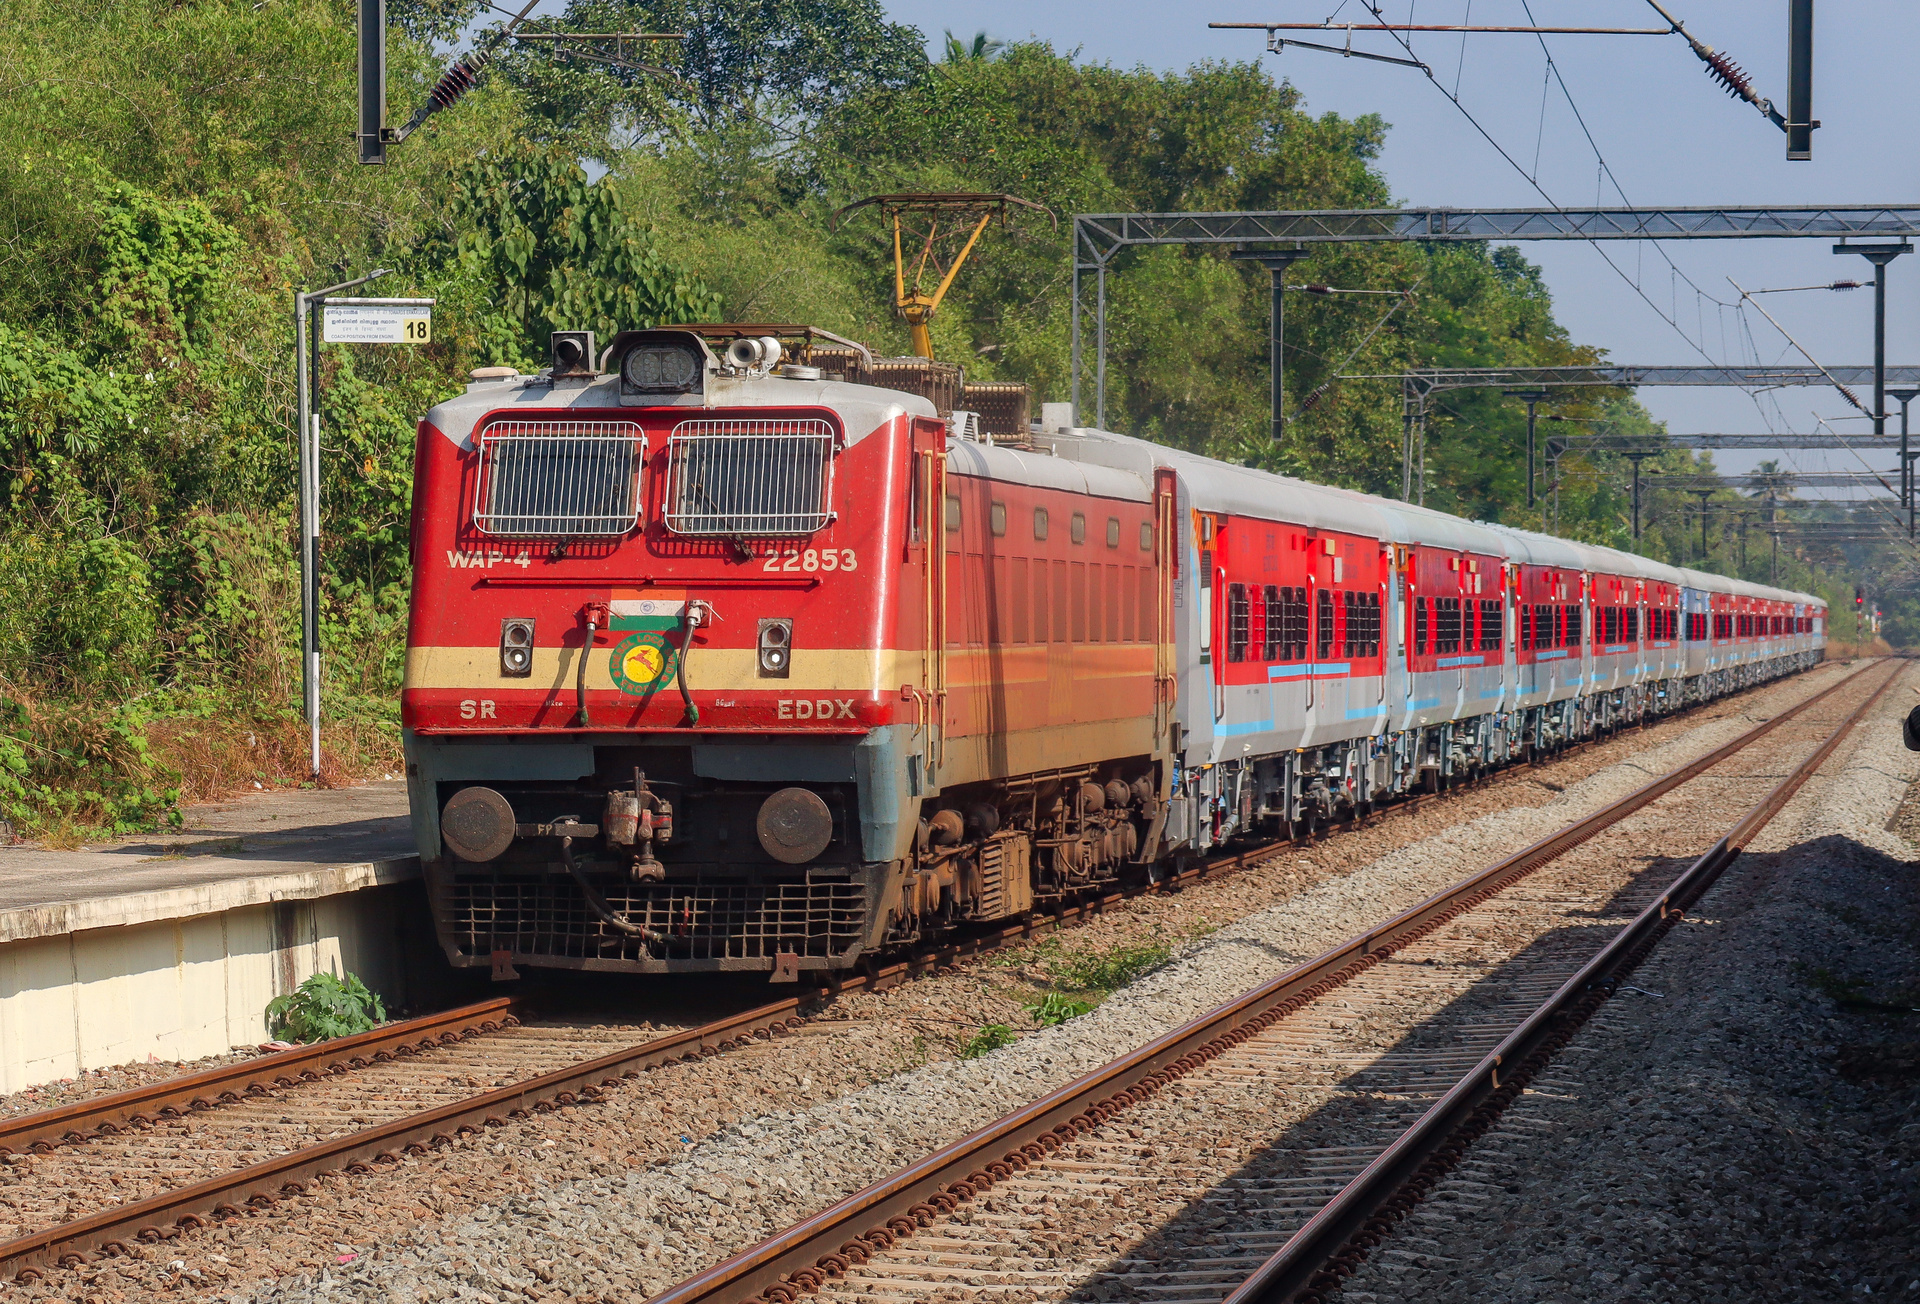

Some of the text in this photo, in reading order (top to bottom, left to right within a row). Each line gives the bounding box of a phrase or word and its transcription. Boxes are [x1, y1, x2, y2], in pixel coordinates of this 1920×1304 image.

[406, 321, 427, 339] 18
[447, 550, 531, 569] WAP-4
[762, 548, 858, 572] 22853
[611, 639, 635, 669] DIESEL
[636, 634, 665, 647] LOCO
[460, 699, 497, 720] SR
[777, 698, 856, 720] EDDX
